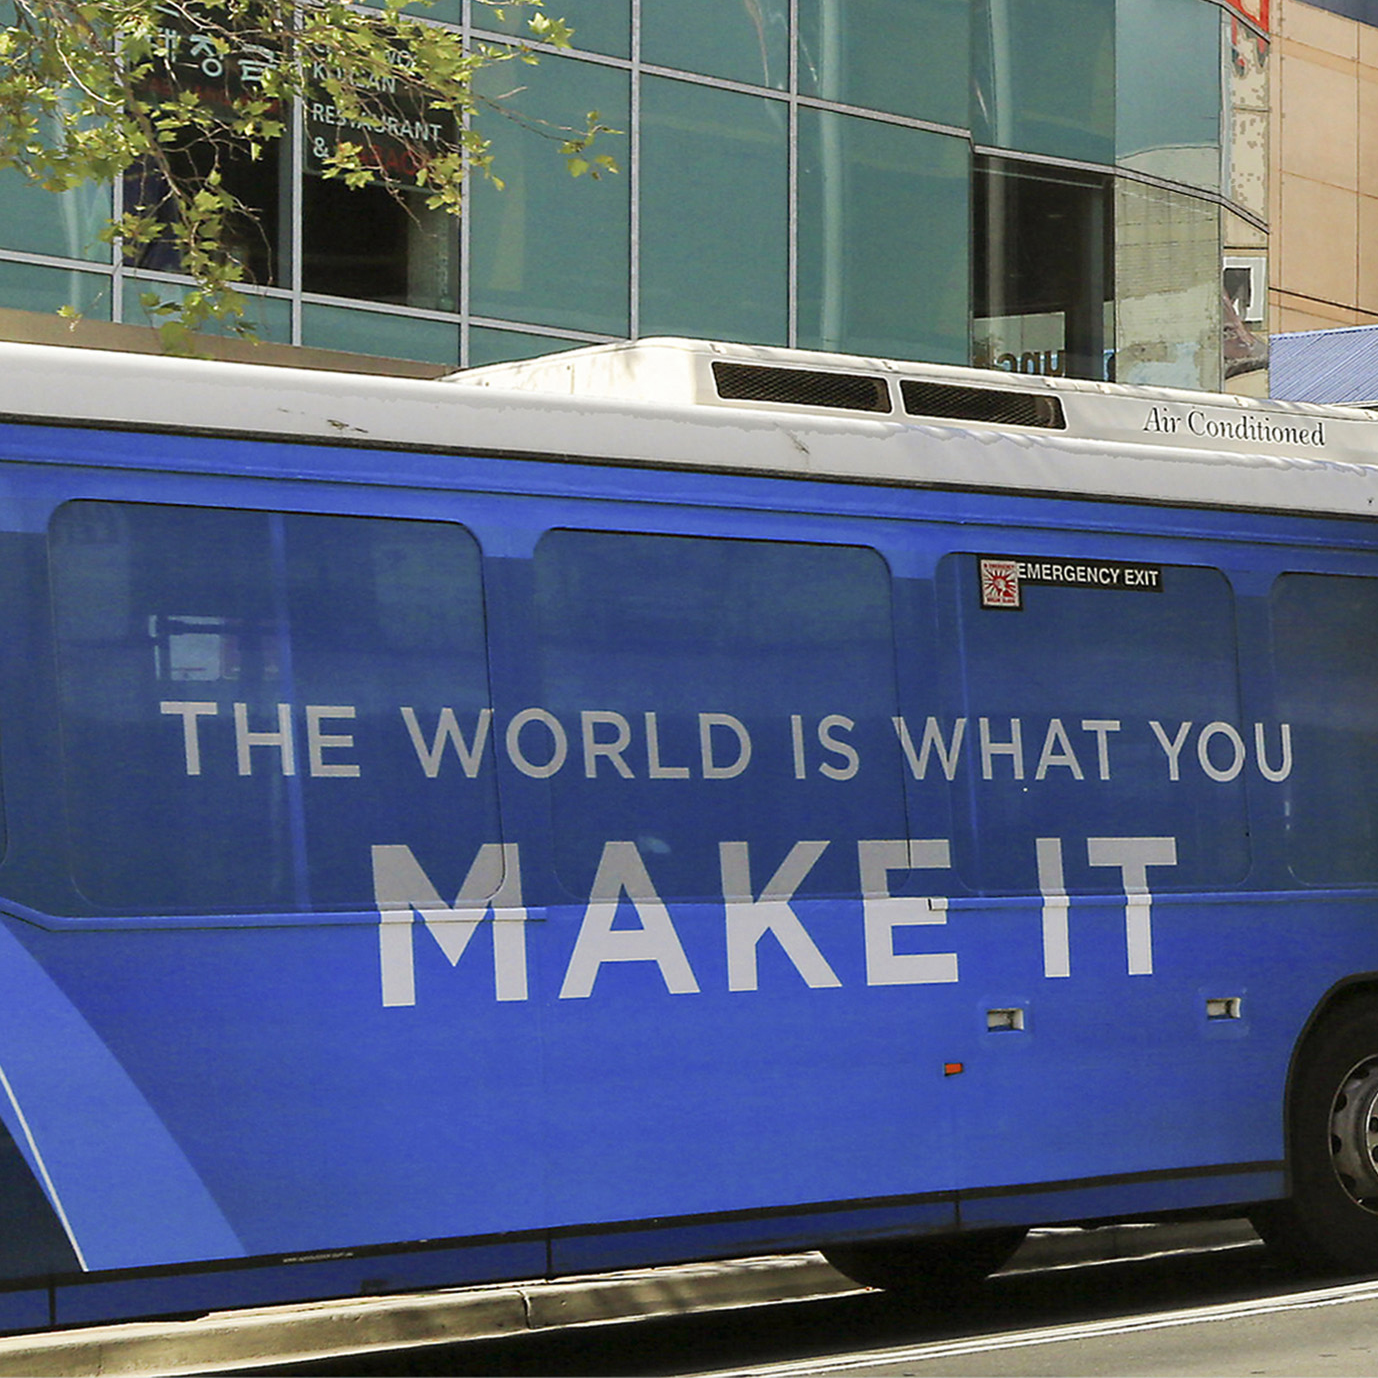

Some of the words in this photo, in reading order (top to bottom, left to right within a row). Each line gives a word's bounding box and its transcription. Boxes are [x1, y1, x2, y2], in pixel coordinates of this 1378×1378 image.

[1142, 407, 1182, 433] Air
[1187, 408, 1327, 447] Conditioned
[1016, 562, 1120, 585] EMERGENCY
[1124, 568, 1159, 587] EXIT
[160, 701, 361, 779] THE
[400, 707, 754, 780] WORLD
[791, 713, 861, 781] IS
[891, 716, 1121, 781] WHAT
[1149, 720, 1293, 783] YOU
[369, 839, 959, 1008] MAKE
[1036, 836, 1178, 978] IT
